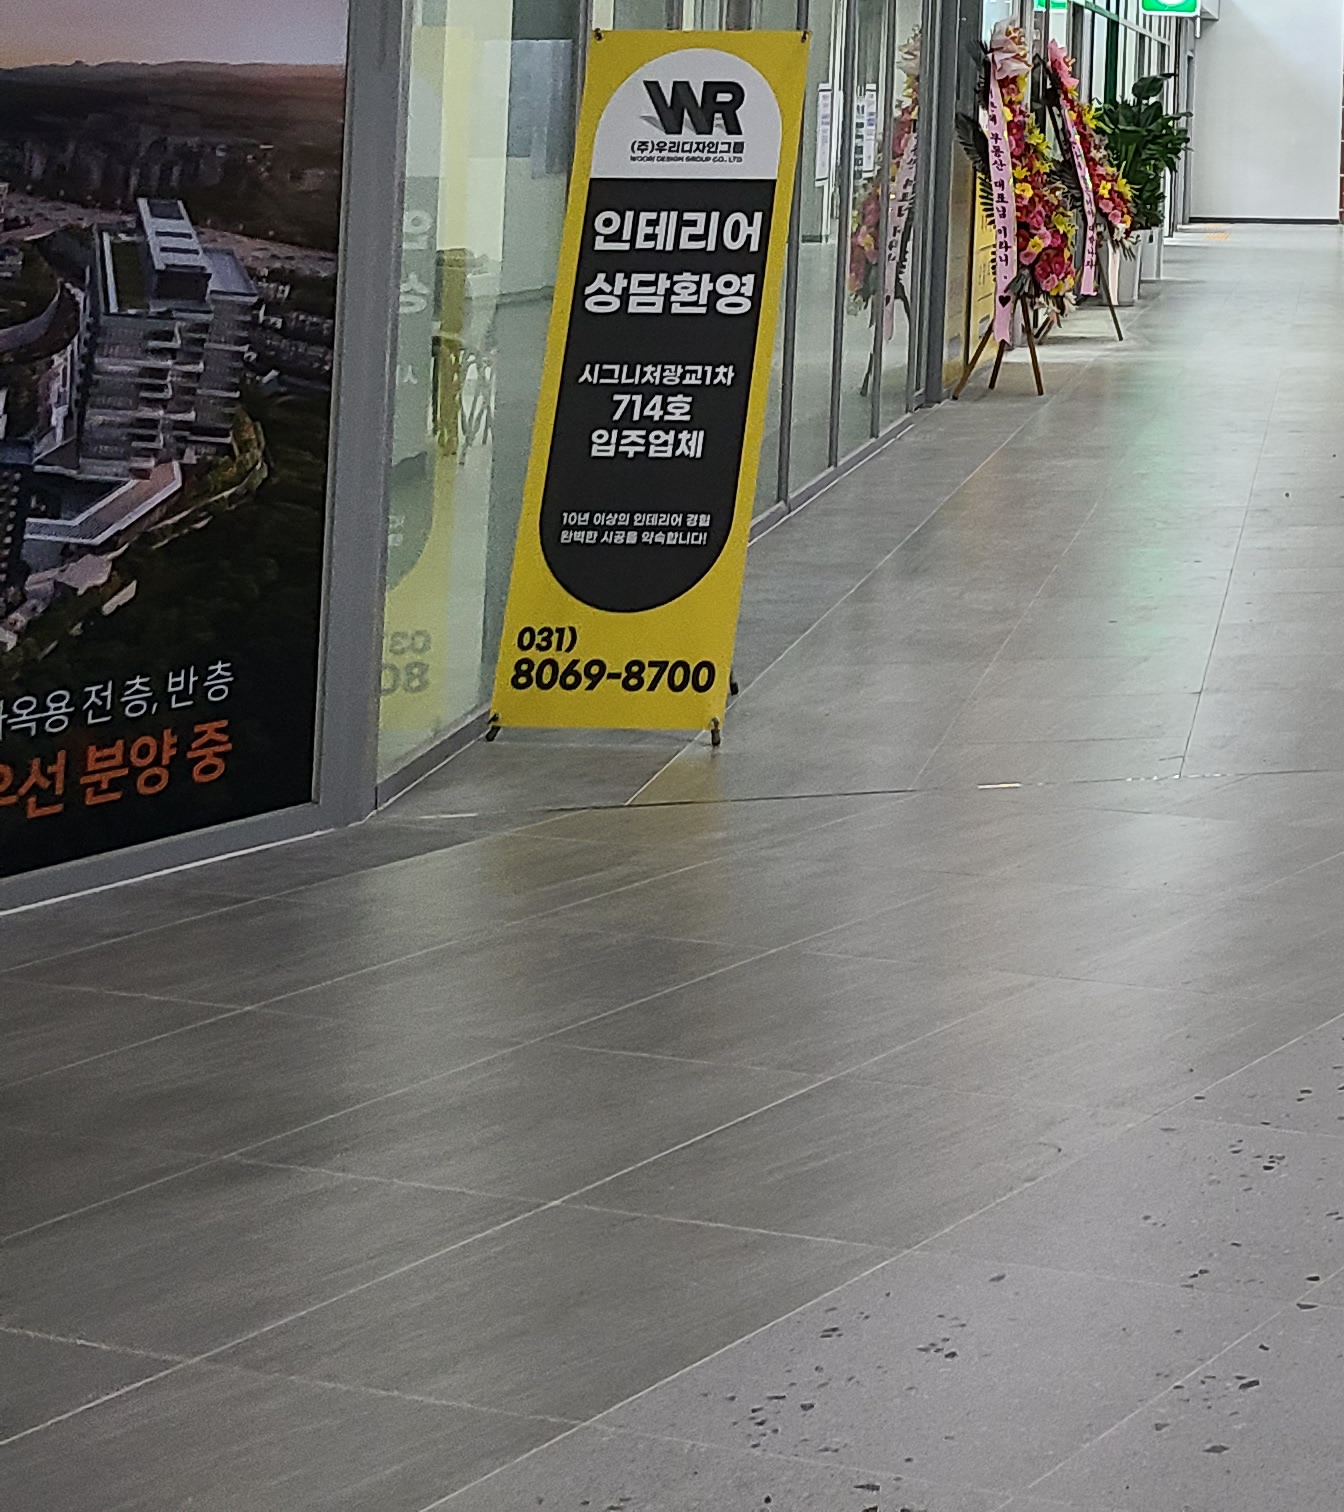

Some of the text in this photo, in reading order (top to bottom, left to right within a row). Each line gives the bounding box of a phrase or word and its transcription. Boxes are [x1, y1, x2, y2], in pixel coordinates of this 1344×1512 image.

[641, 79, 746, 136] WR
[592, 209, 763, 253] 인테리어
[583, 271, 756, 315] 상담환영
[577, 362, 735, 387] 시그니처광교1차
[611, 393, 693, 422] 714호
[590, 429, 705, 459] 입주업체
[592, 512, 631, 527] 이상의
[633, 512, 683, 527] 인테리어
[516, 625, 578, 654] 031)
[510, 657, 717, 693] 8069-8700
[79, 727, 178, 807] 분양
[186, 719, 233, 784] 중
